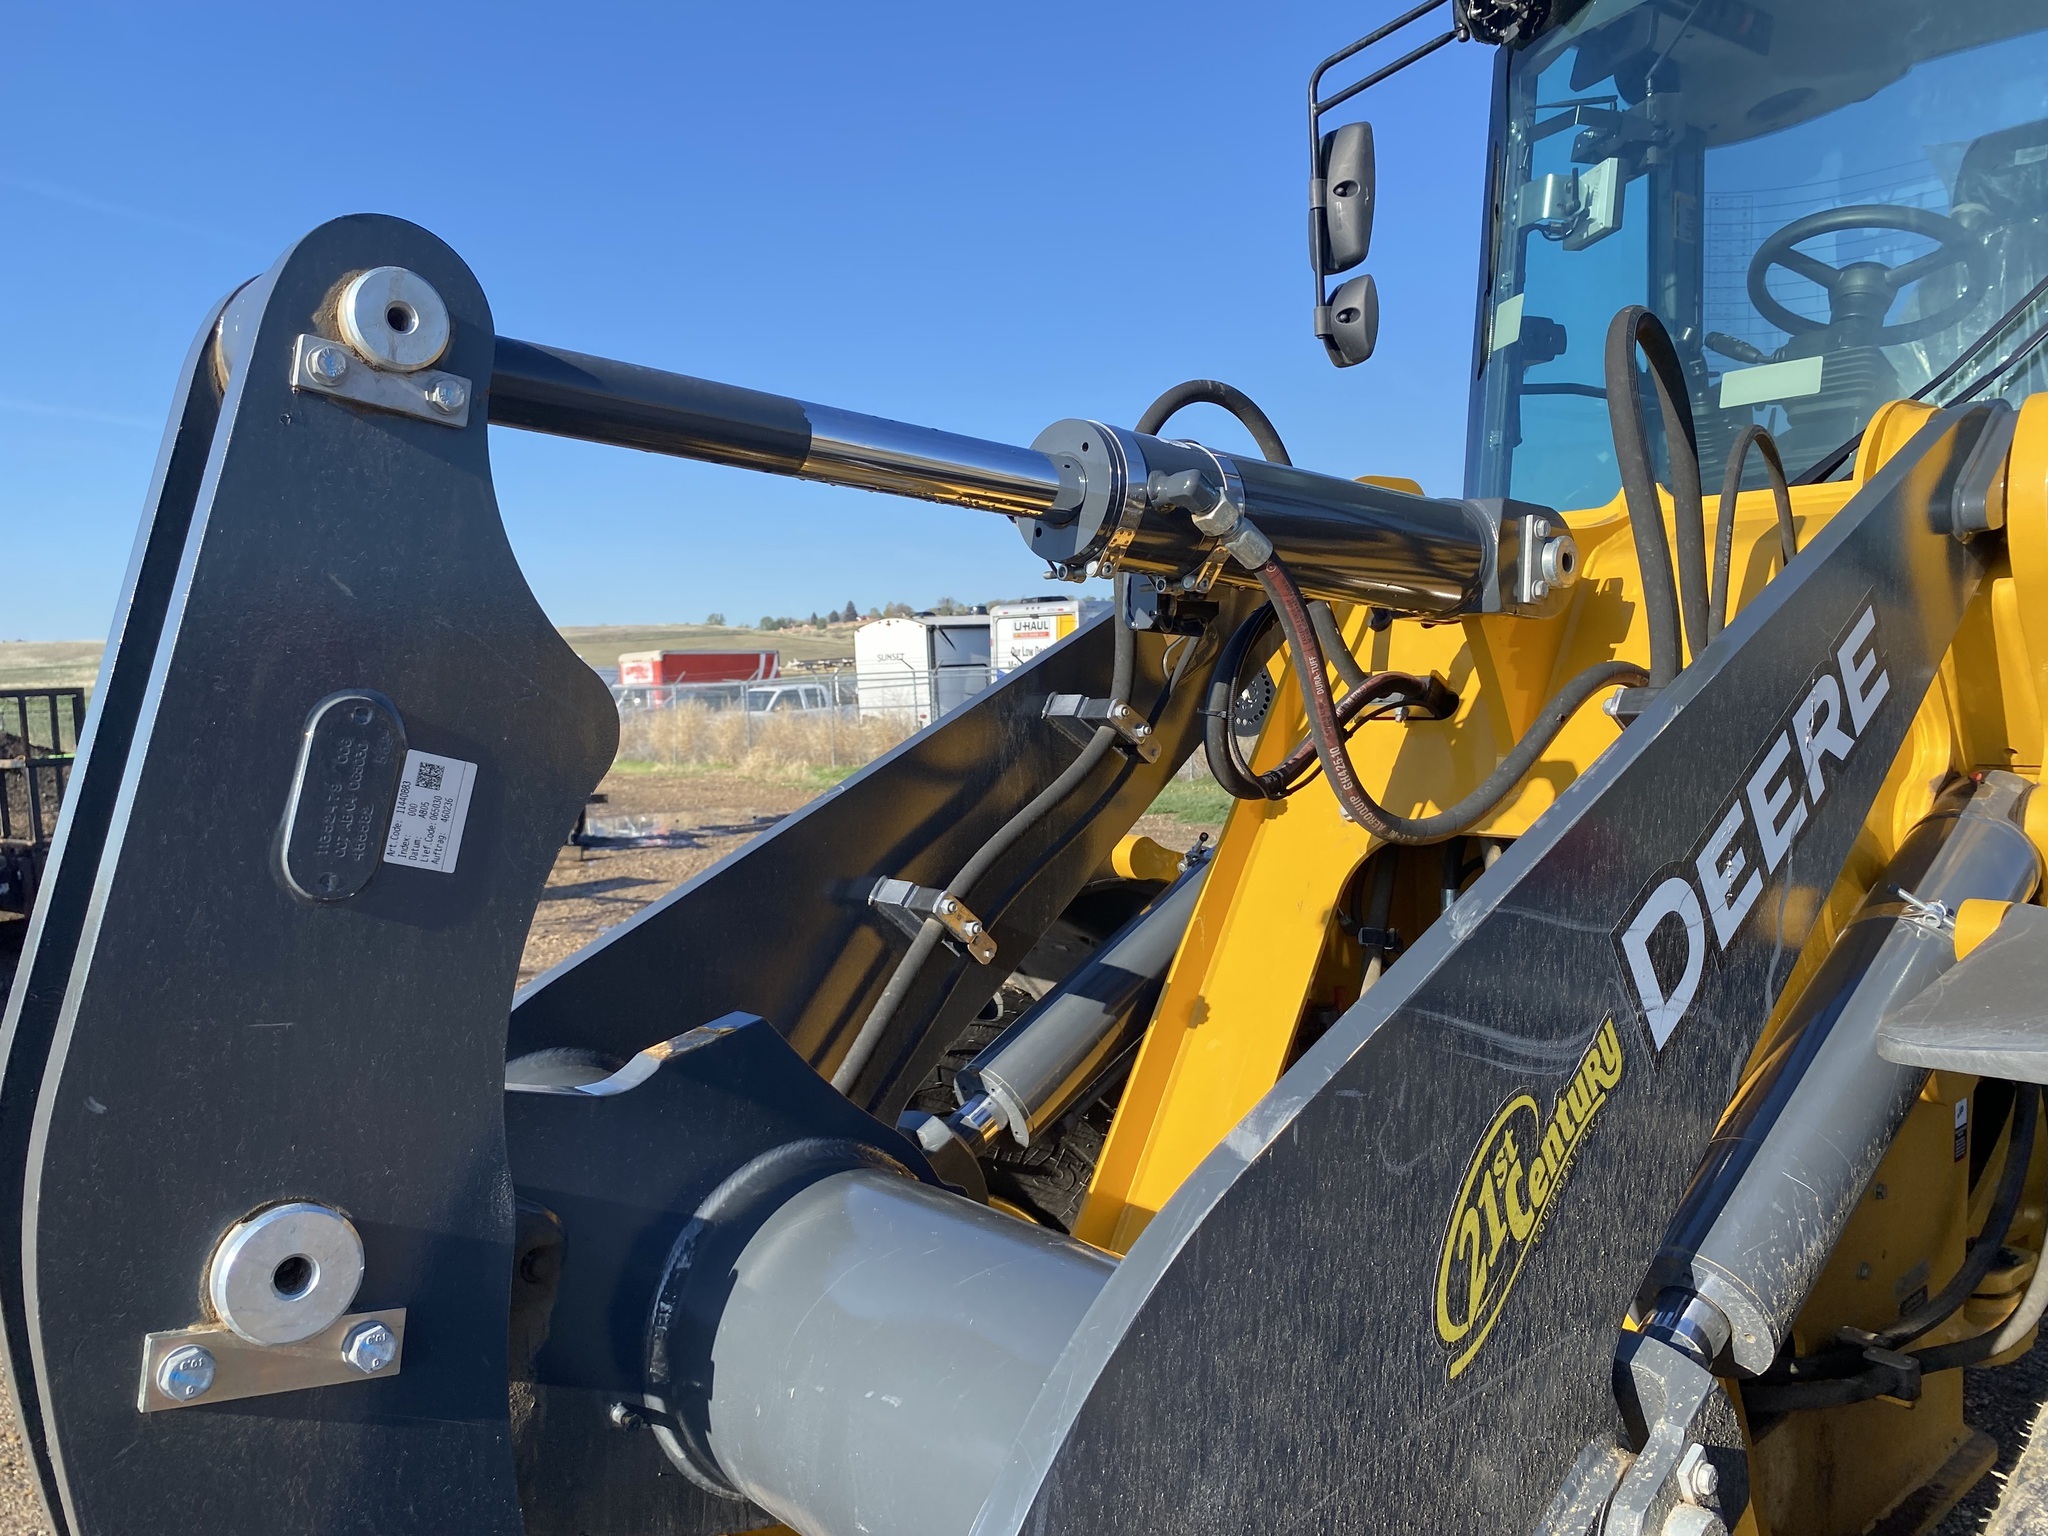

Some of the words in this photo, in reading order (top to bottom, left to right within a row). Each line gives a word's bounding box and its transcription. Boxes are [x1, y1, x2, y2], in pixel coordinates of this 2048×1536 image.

[1011, 646, 1021, 657] Our
[1022, 646, 1034, 657] Low
[1014, 621, 1049, 631] U-HAUL
[877, 653, 905, 662] SUNSET
[1309, 656, 1325, 694] DURA-TUFF
[1331, 746, 1352, 790] GH425-10
[387, 819, 403, 857] Art.Code:
[395, 780, 412, 814] 11440883
[398, 834, 411, 858] Index:
[407, 803, 418, 817] 000
[409, 836, 422, 861] Datum:
[418, 801, 430, 819] AB05
[420, 822, 437, 862] Lief.Code:
[429, 795, 443, 821] 065030
[431, 832, 447, 865] Auftrag:
[440, 797, 454, 823] 460236
[1350, 795, 1386, 832] AEROQUIP
[1621, 604, 1891, 1052] DEERE
[1458, 1129, 1520, 1326] 21st
